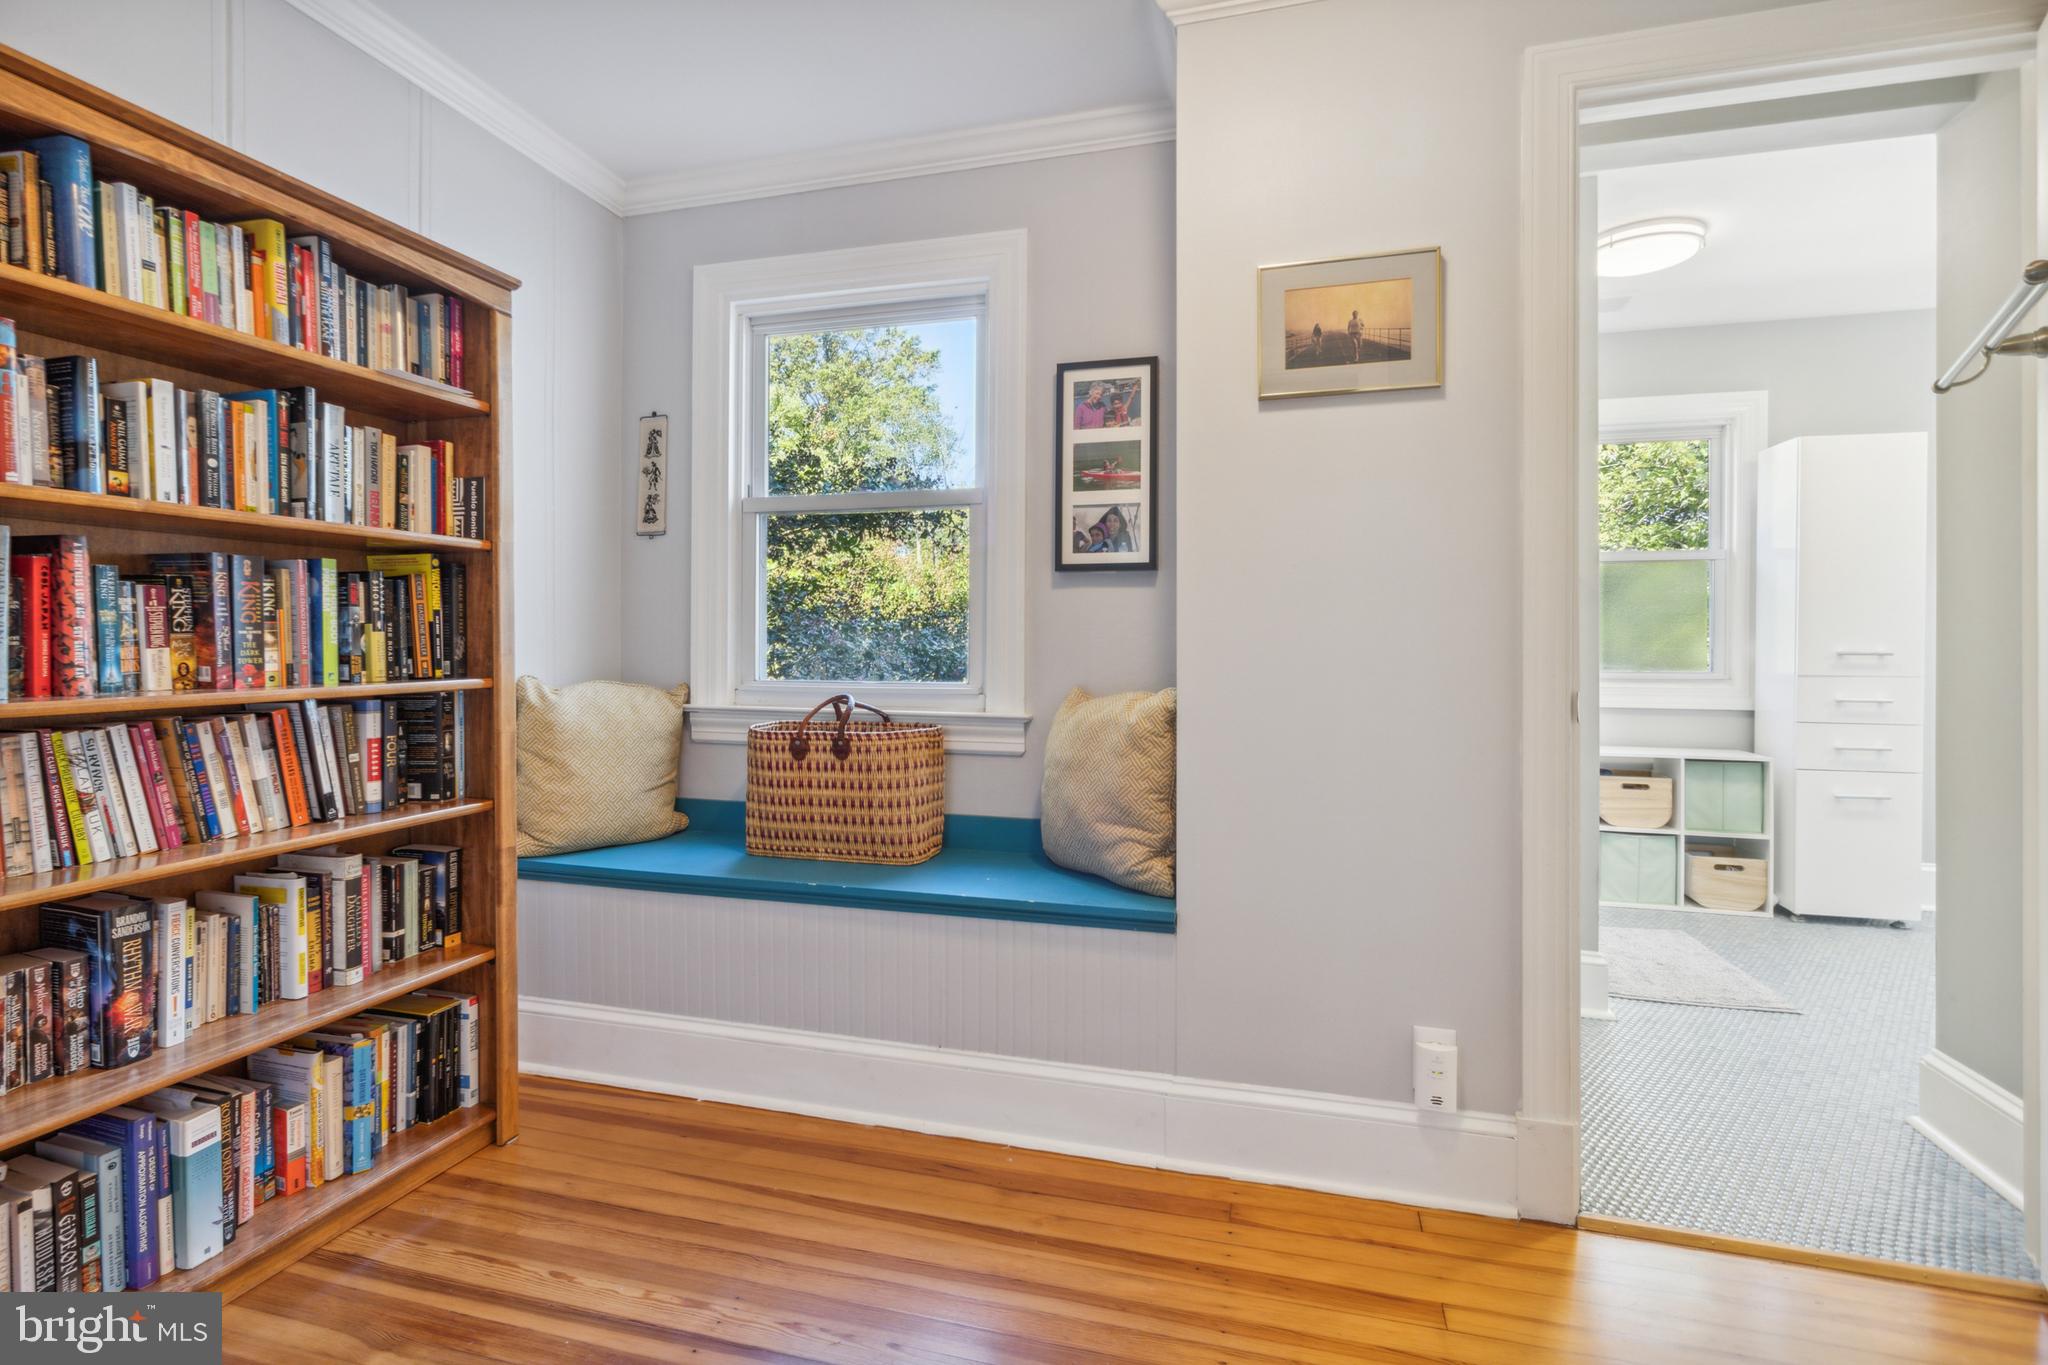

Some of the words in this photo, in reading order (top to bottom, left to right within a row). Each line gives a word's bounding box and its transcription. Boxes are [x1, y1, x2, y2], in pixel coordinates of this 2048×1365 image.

[118, 420, 126, 438] NEIL
[119, 438, 128, 470] GAIMAN
[74, 550, 84, 587] BRIGHTNESS
[215, 572, 227, 597] KING
[100, 579, 108, 599] KING
[107, 571, 116, 607] STEPHEN
[239, 581, 262, 624] KING
[432, 568, 441, 610] WATCHMEN
[148, 612, 164, 634] STEPHEN
[169, 588, 188, 632] KING
[416, 604, 425, 635] MADELINE
[74, 640, 84, 664] GAVRIEL
[419, 635, 427, 656] MILLER
[26, 739, 39, 770] Choke
[386, 735, 397, 767] FOUR
[29, 774, 42, 801] Chuck
[52, 784, 61, 808] CHUCK
[54, 739, 65, 763] CHUCK
[61, 764, 76, 805] PALAHNIUK
[71, 809, 86, 842] LULLABY
[34, 805, 47, 850] Palahniuk
[56, 809, 67, 848] PALAHNIUK
[450, 863, 458, 889] STEPHENSON
[171, 913, 181, 937] FIERCE
[347, 894, 357, 952] DAUGHTER
[122, 938, 142, 993] RHYTHM
[171, 937, 181, 996] CONVERSATIONS
[124, 1002, 143, 1035] WAR
[34, 1042, 42, 1076] SANDERSON
[69, 1034, 78, 1072] SANDERSON
[75, 1035, 84, 1066] BRANDON
[220, 1101, 232, 1144] ROBERT
[241, 1100, 251, 1131] REBECCA
[137, 1151, 147, 1208] APPROXIMATION
[148, 1156, 156, 1184] DESIGN
[220, 1147, 232, 1192] JORDAN
[138, 1208, 148, 1253] ALGORITHMS
[33, 1227, 54, 1292] MIDDLESEX
